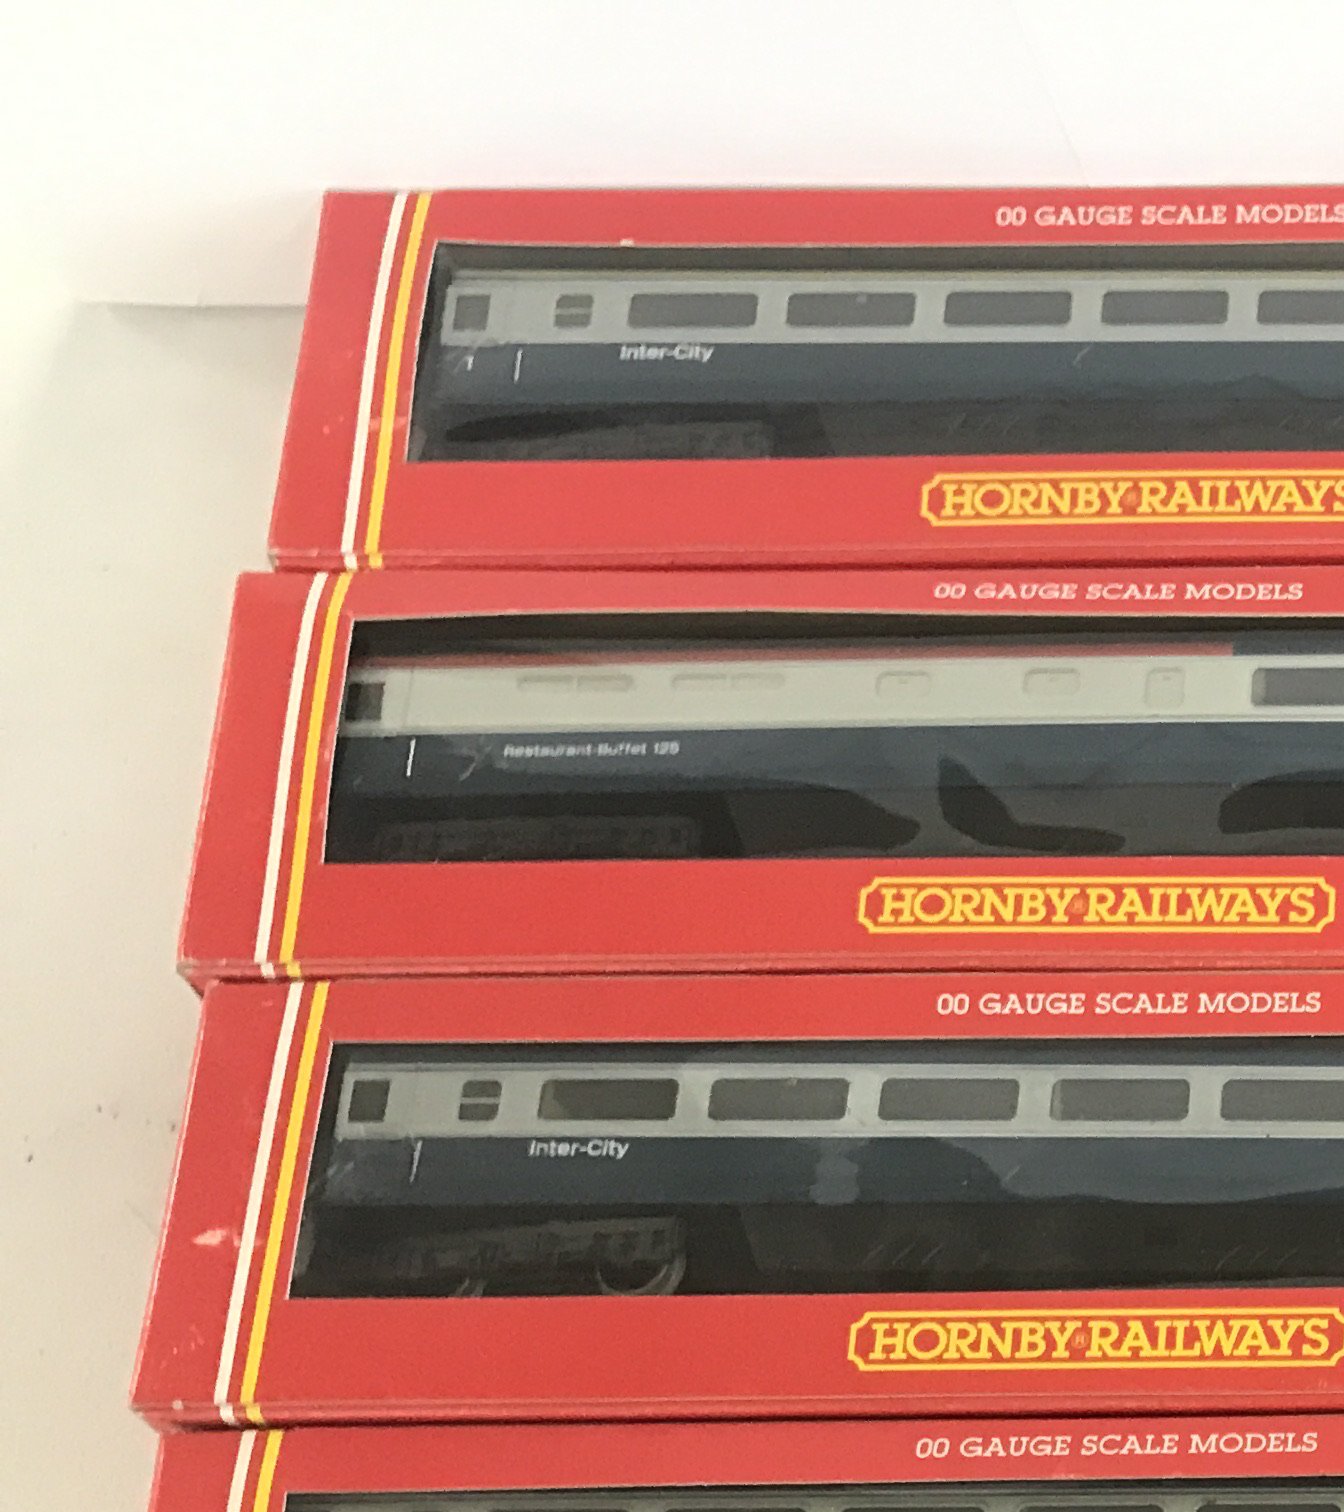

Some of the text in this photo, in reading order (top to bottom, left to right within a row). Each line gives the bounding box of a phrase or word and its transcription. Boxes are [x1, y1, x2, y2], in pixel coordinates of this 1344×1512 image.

[1034, 205, 1133, 226] GAUGE
[1140, 205, 1227, 225] SCALE
[619, 345, 714, 363] Inter-City
[974, 583, 1078, 600] GAUGE
[1085, 583, 1177, 600] SCALE
[1184, 583, 1303, 601] MODELS
[1084, 887, 1314, 922] RAILWAYS
[978, 992, 1086, 1015] GAUGE
[1094, 992, 1189, 1014] SCALE
[1197, 991, 1321, 1014] MODELS
[528, 1139, 630, 1159] Inter-City
[1086, 1318, 1328, 1357] RAILWAYS
[959, 1435, 1072, 1458] GAUGE
[1080, 1434, 1180, 1456] SCALE
[1188, 1432, 1318, 1454] MODELS
